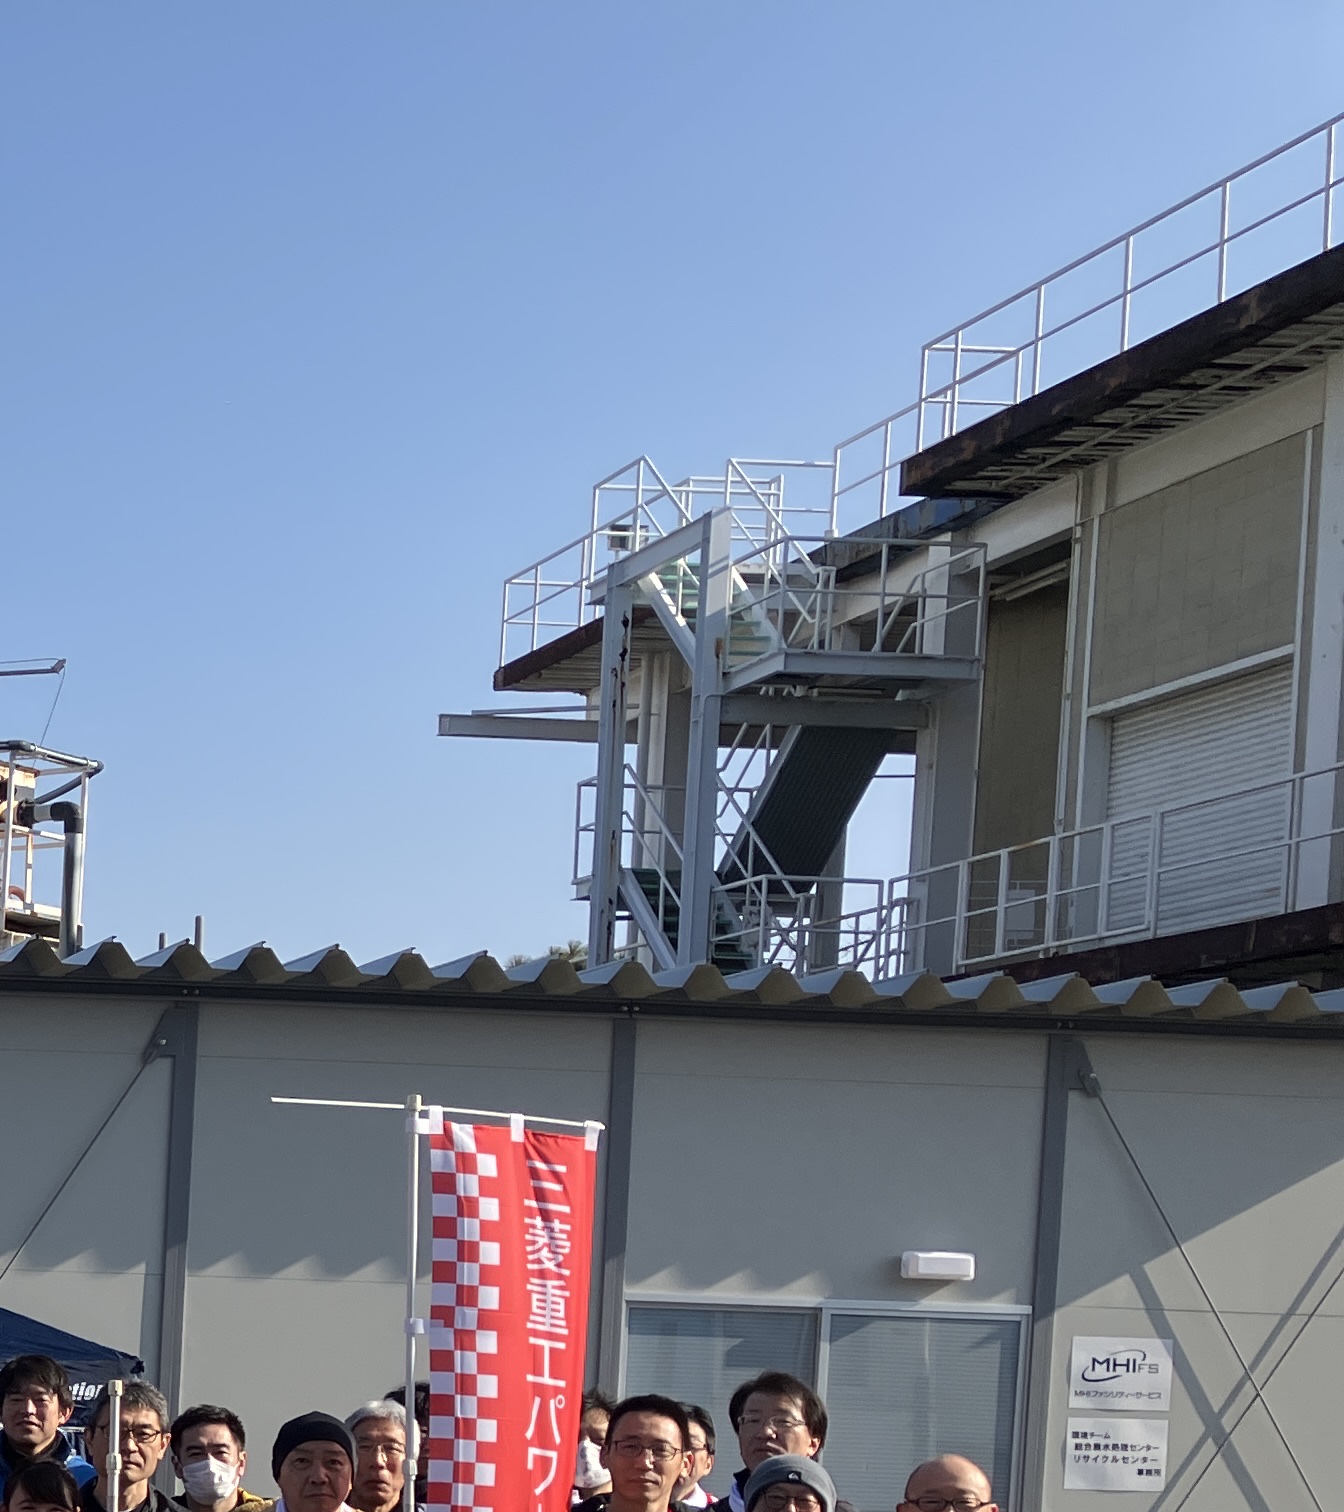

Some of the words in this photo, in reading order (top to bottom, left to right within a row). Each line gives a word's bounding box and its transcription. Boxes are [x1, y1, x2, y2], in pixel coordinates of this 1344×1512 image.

[1073, 1454, 1159, 1464] リサイクルセンター
